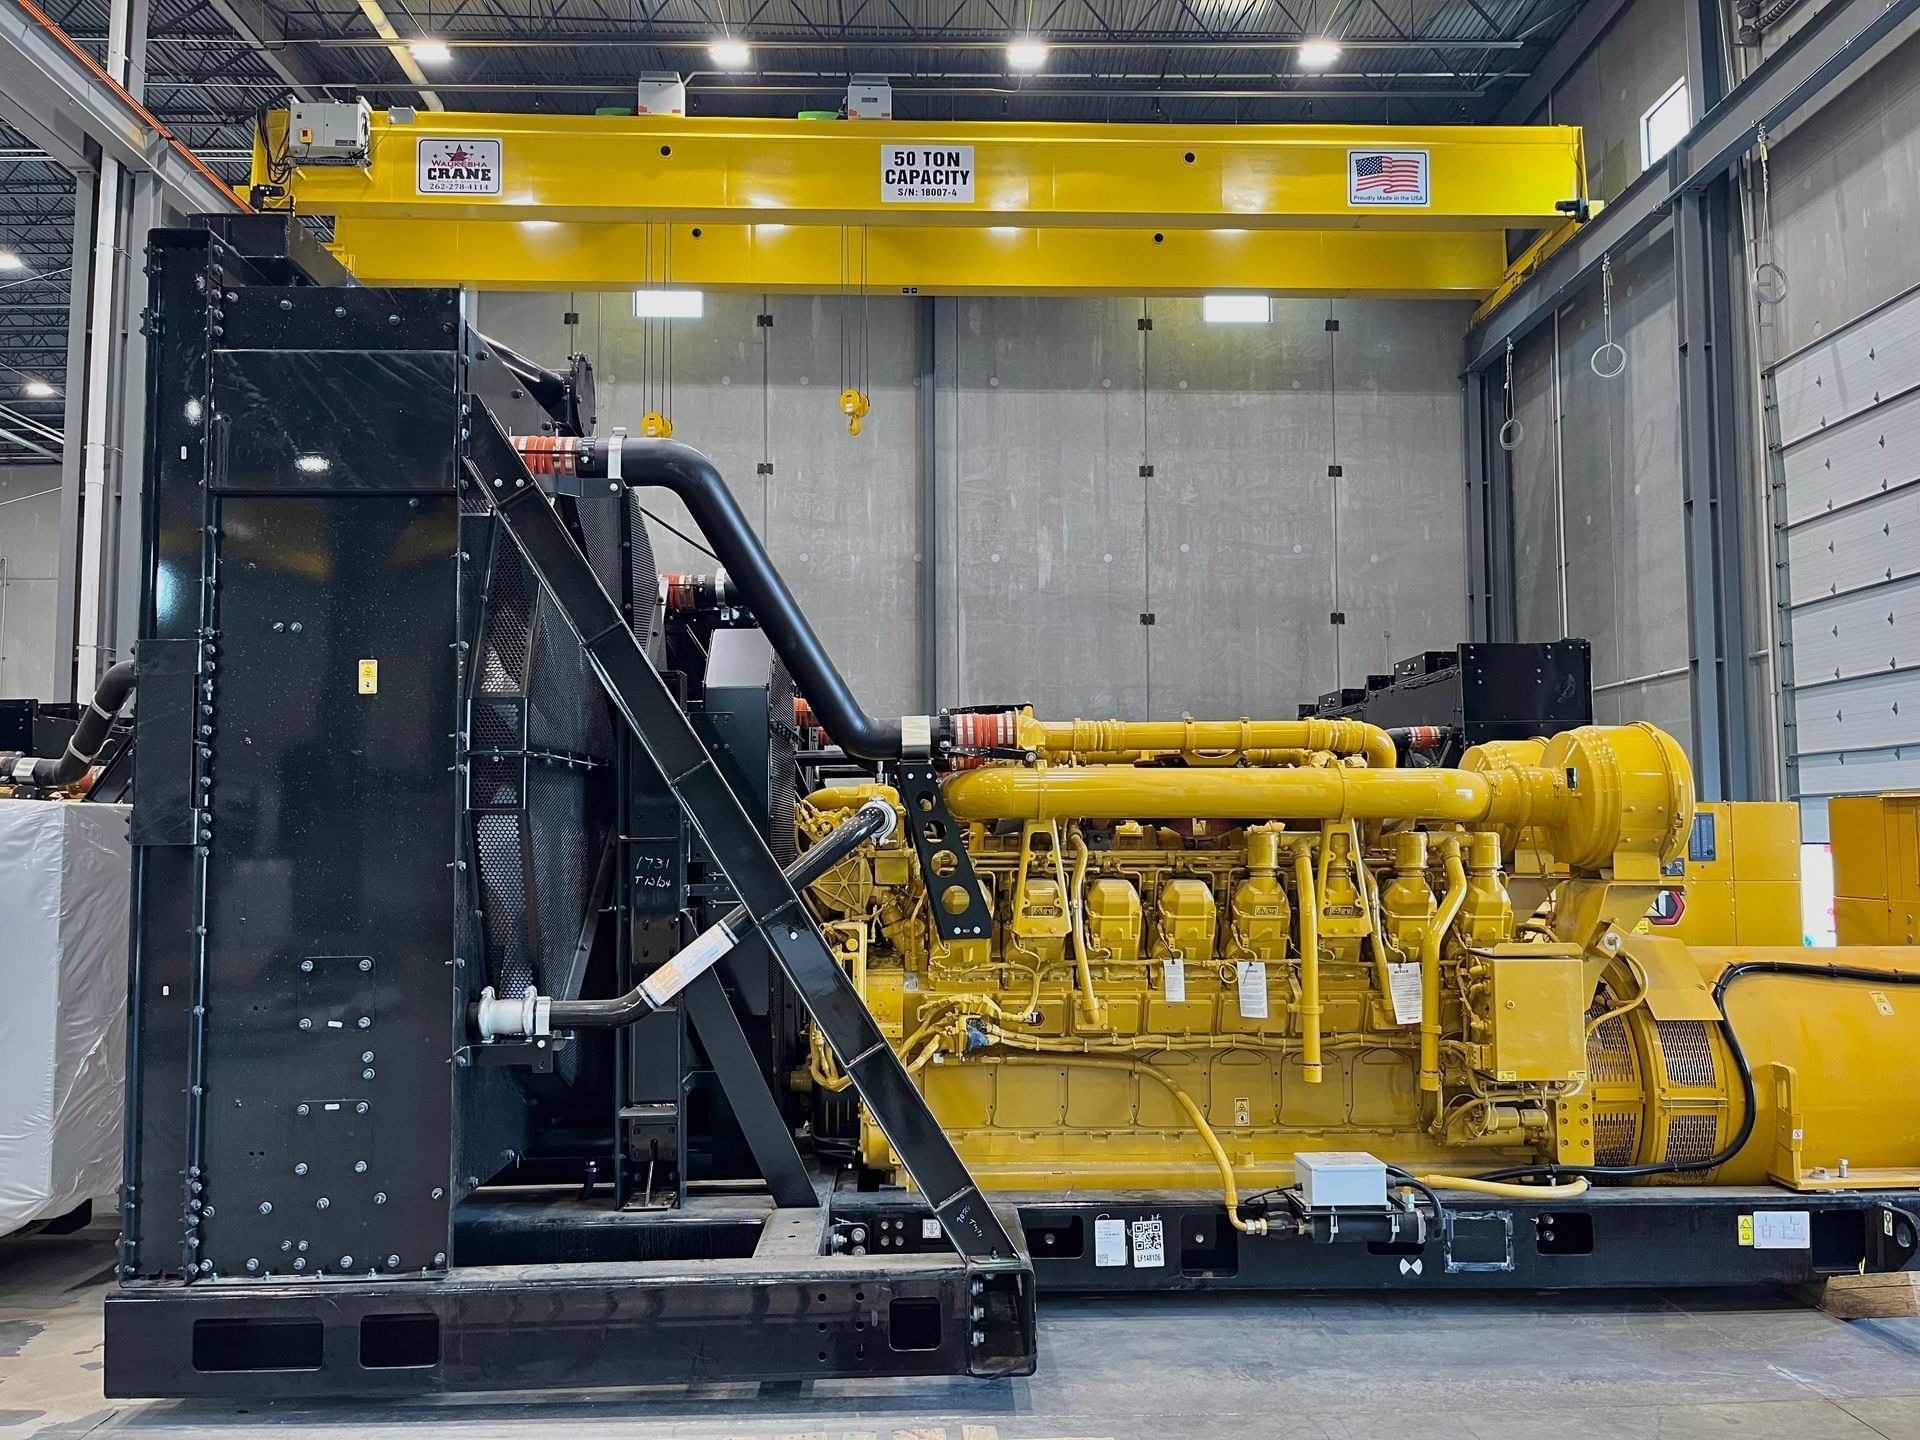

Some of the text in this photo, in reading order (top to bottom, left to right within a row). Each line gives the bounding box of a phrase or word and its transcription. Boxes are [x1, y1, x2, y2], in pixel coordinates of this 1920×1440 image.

[894, 151, 960, 167] 50 TON
[427, 167, 491, 181] CRANE
[885, 169, 970, 185] CAPACITY
[429, 183, 489, 191] 262-278-4114
[897, 188, 957, 197] S/N: 18007-4
[636, 856, 670, 870] 1731
